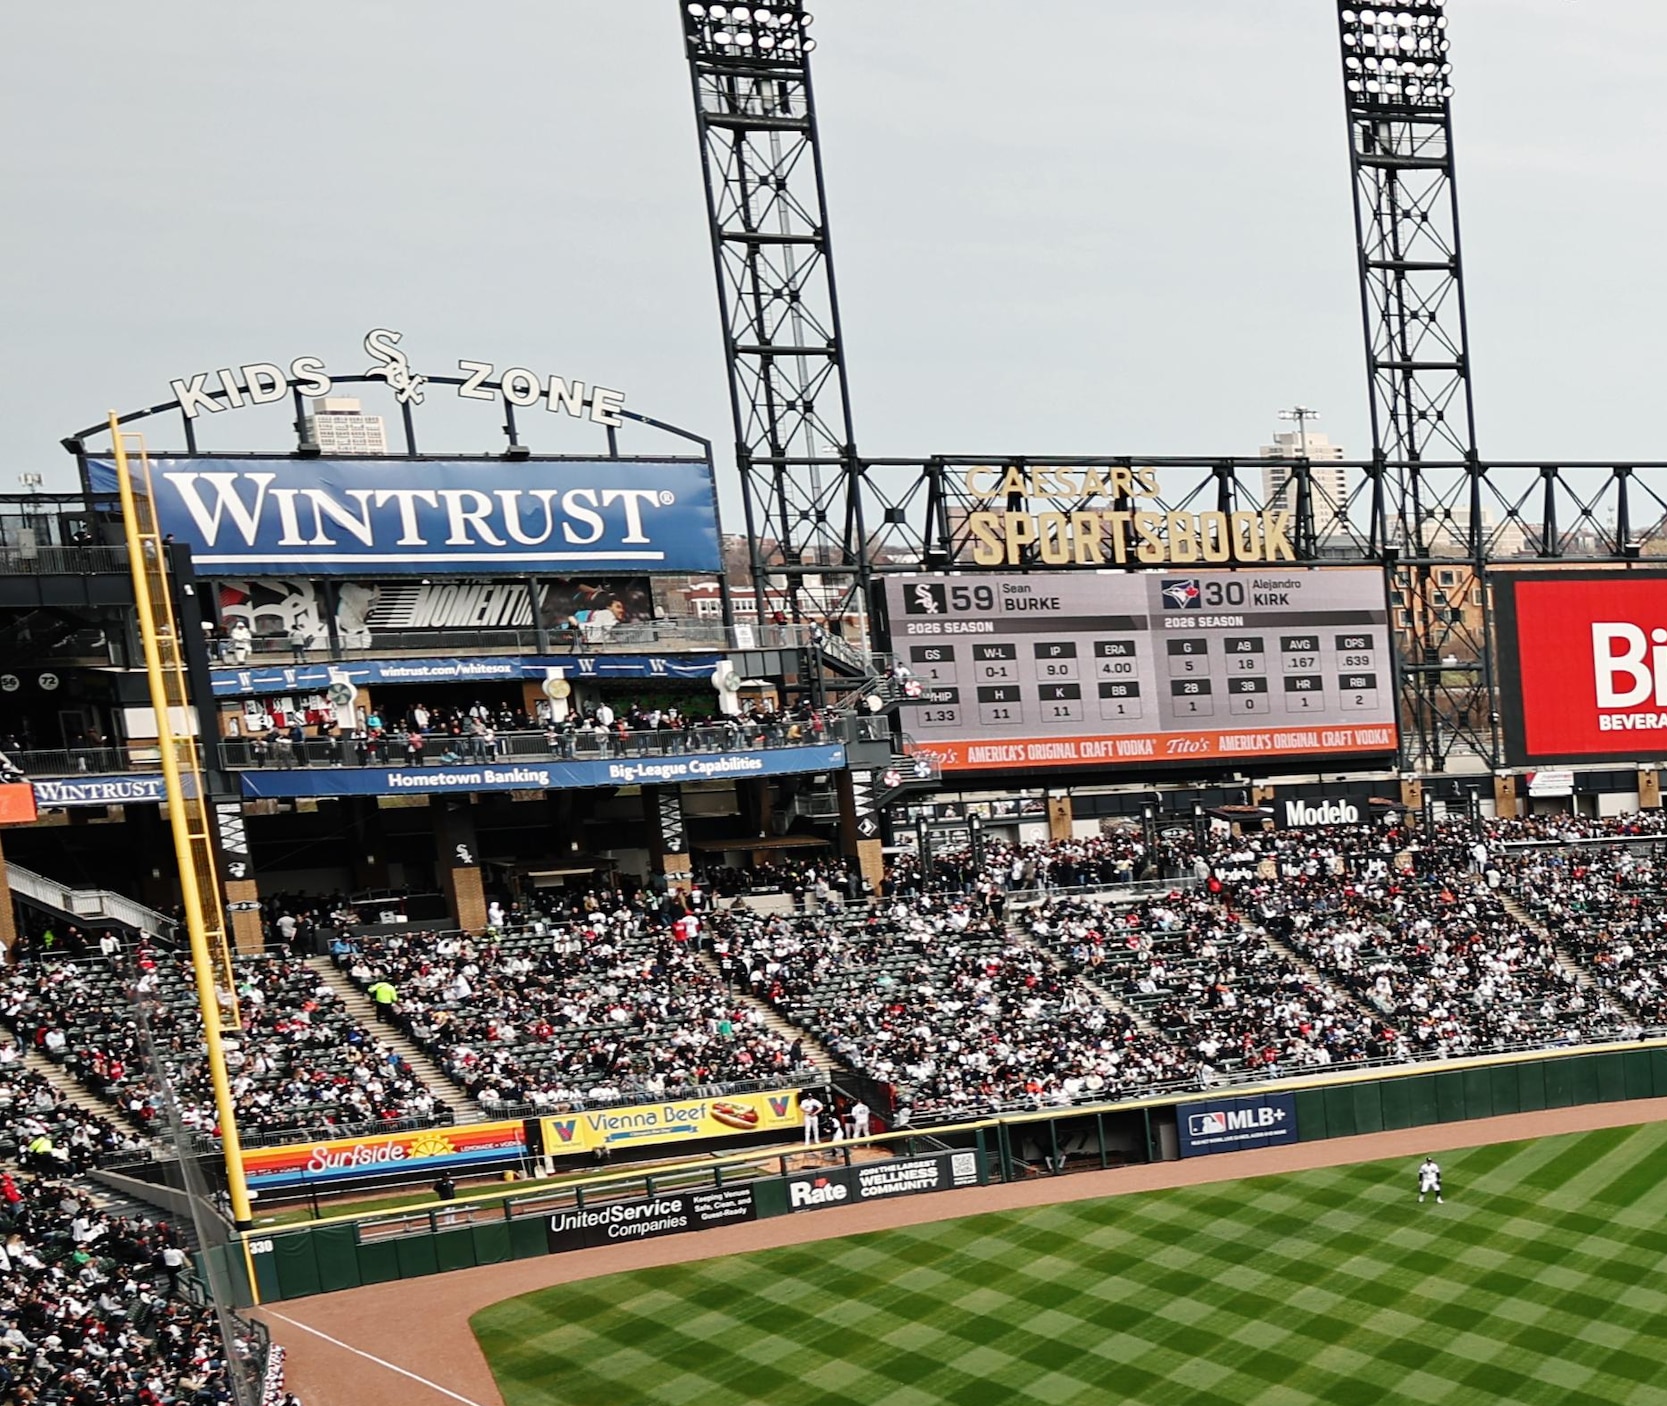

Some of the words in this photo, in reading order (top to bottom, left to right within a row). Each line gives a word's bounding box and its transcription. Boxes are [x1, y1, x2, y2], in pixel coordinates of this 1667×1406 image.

[170, 356, 332, 418] KIDS
[458, 359, 626, 428] ZONE
[966, 466, 1161, 500] CAESARS
[968, 510, 1296, 565] SPORTSBOOK
[1003, 583, 1031, 594] Sean
[1205, 581, 1245, 607] 30
[1253, 578, 1301, 593] Alejandro
[951, 585, 993, 612] 59
[1005, 597, 1060, 611] BURKE
[1254, 593, 1290, 606] KIRK
[379, 661, 512, 678] wintrust.com/whitesox
[388, 771, 481, 788] Hometown
[485, 768, 549, 788] Banking
[609, 758, 685, 782] Big-League
[688, 754, 763, 778] Capabilities
[1286, 799, 1358, 827] Modelo
[586, 1108, 658, 1132] Vienna
[664, 1102, 707, 1122] Beef
[1228, 1106, 1286, 1131] MLB+
[308, 1141, 405, 1174] Surfside
[859, 1167, 937, 1187] WELLNESS
[860, 1177, 939, 1199] COMMUNITY
[790, 1178, 848, 1206] Rate
[608, 1214, 688, 1238] Companies
[249, 1240, 274, 1253] 330
